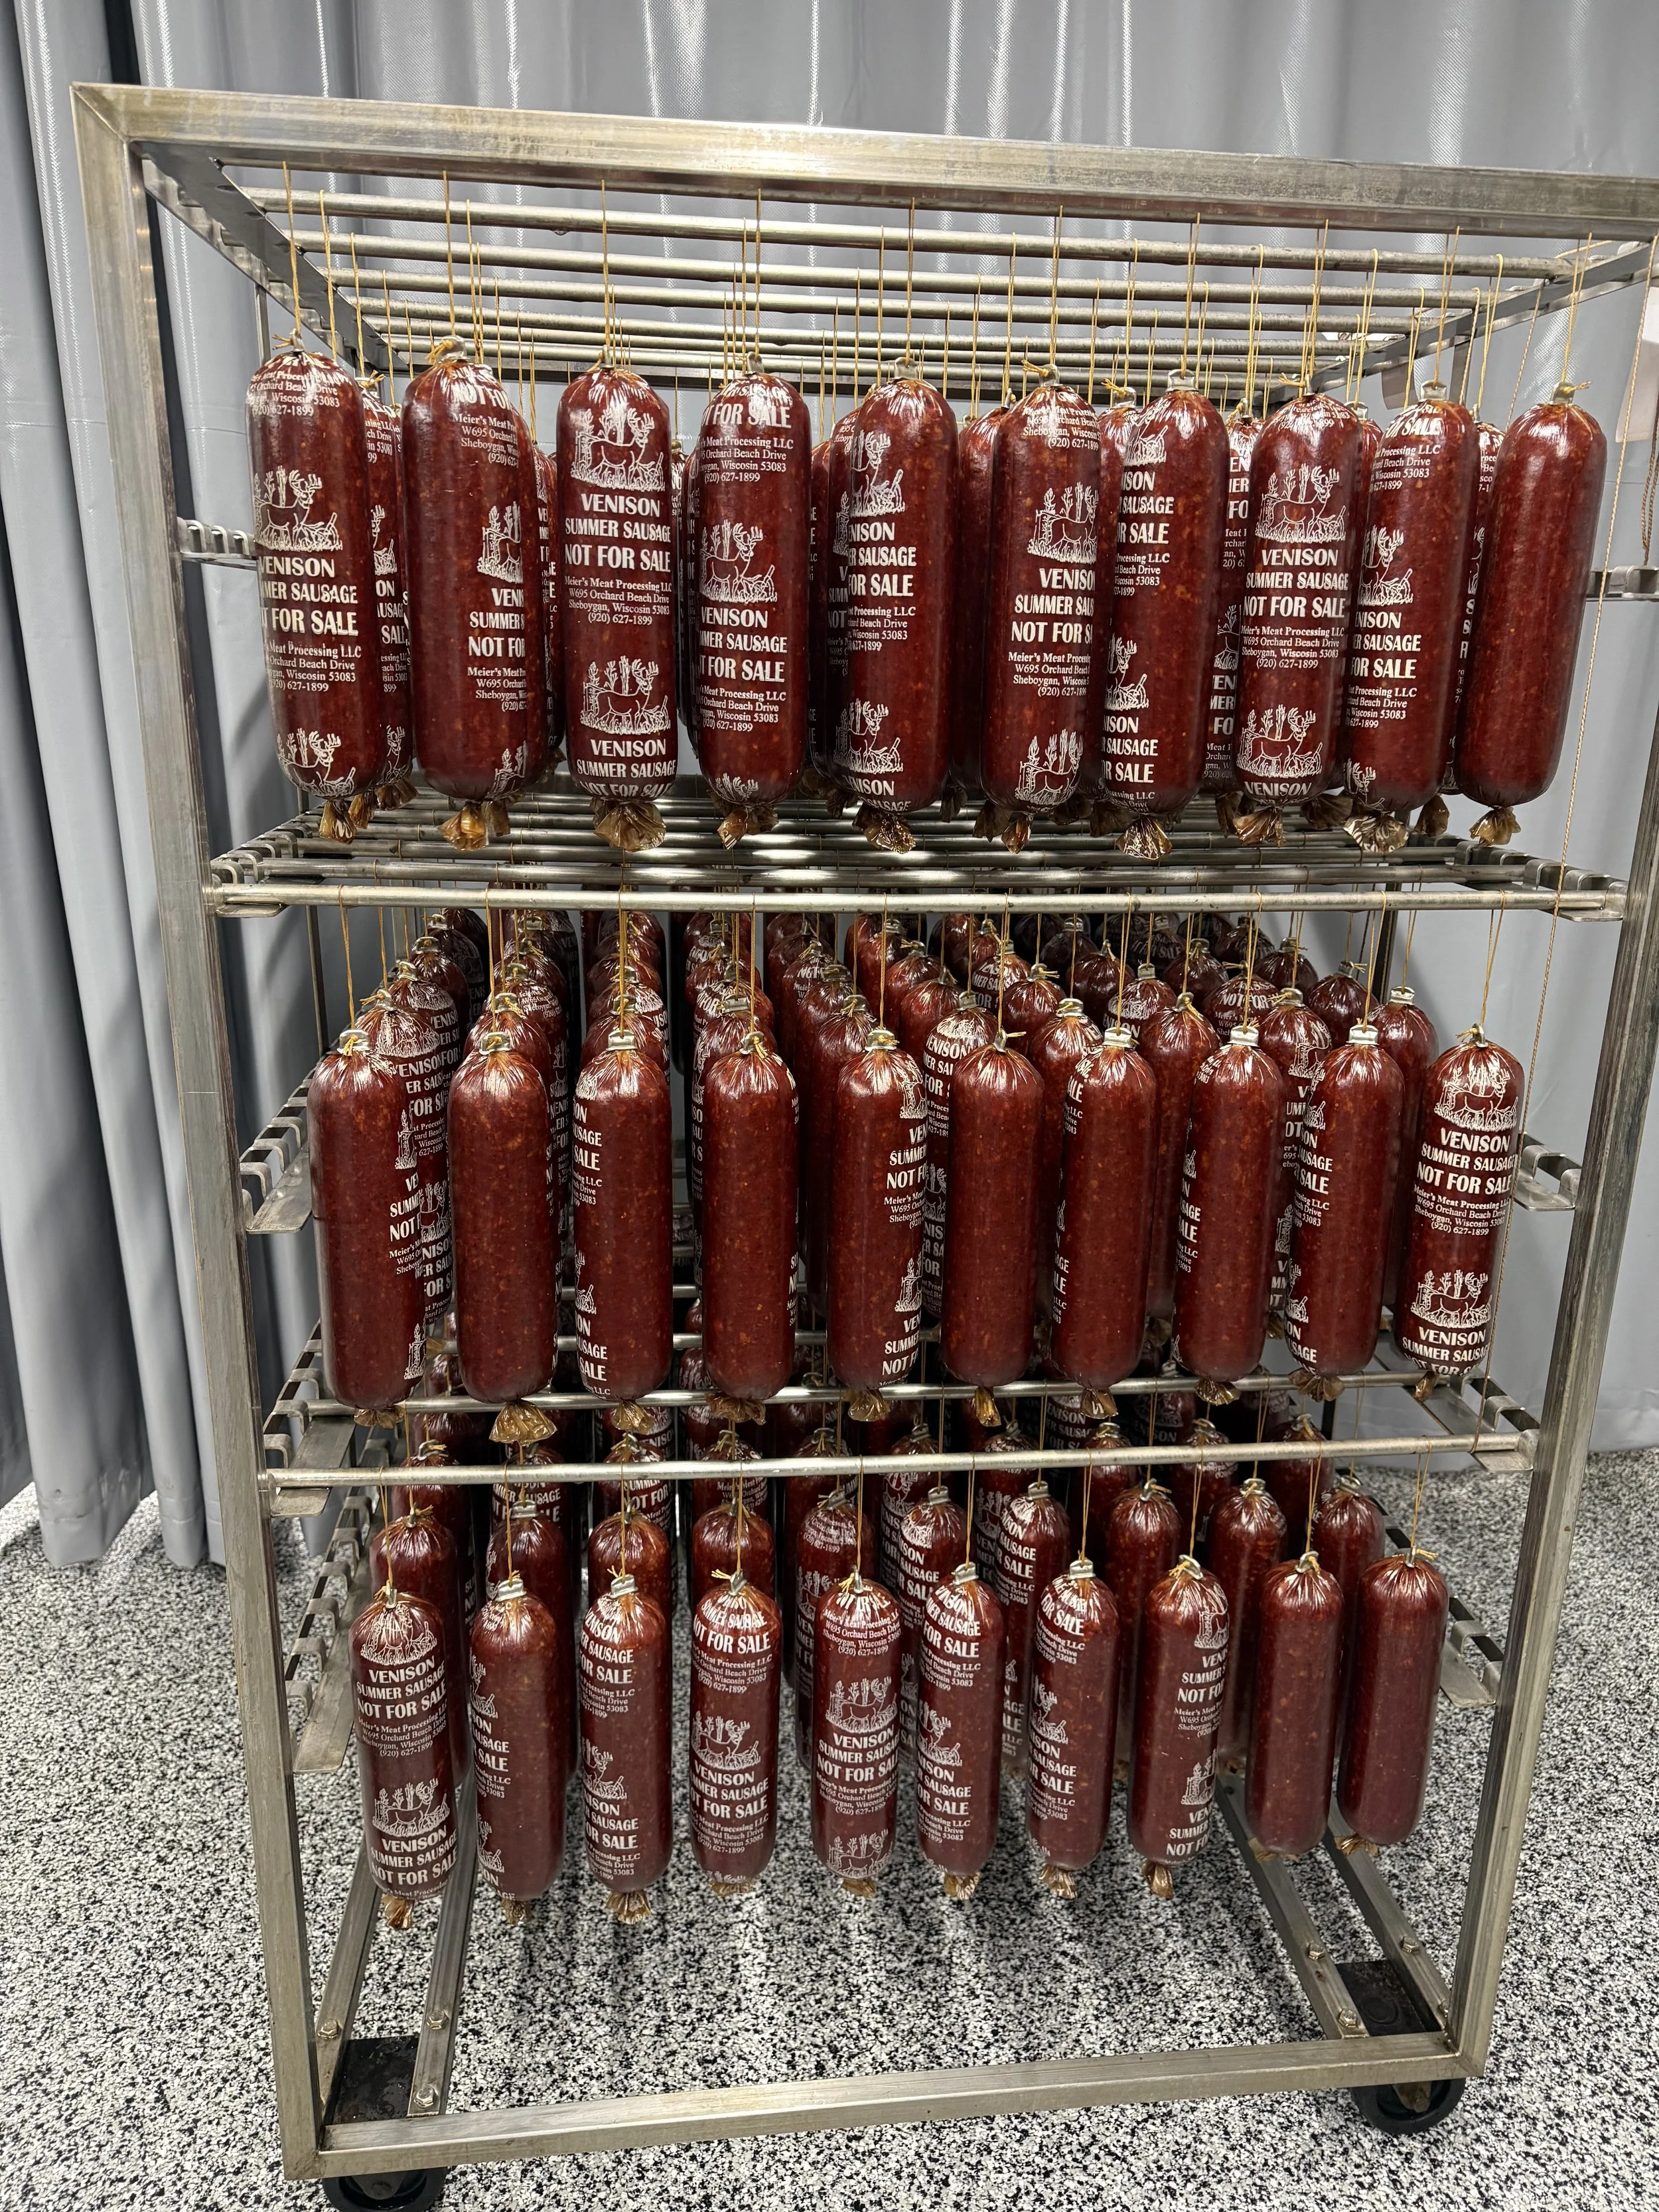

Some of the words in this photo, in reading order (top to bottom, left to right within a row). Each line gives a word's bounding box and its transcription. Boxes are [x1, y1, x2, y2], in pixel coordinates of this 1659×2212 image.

[314, 396, 340, 407] 53083
[462, 426, 487, 437] W695
[773, 437, 794, 449] LLC
[1048, 437, 1070, 449] (920)
[1071, 438, 1099, 451] 627-1899
[1418, 445, 1441, 455] LLC
[734, 448, 760, 459] Beach
[762, 449, 787, 460] Drive
[1406, 457, 1431, 466] Drive
[760, 461, 786, 472] 53083
[1403, 468, 1429, 478] 53083
[721, 472, 760, 482] 627-1899
[581, 493, 660, 518] VENISON
[1122, 496, 1175, 514] SAUSAGE
[565, 518, 618, 538] SUMMER
[623, 521, 671, 543] SAUSAGE
[1129, 522, 1170, 544] SALE
[565, 544, 593, 565] NOT
[597, 545, 635, 570] FOR
[640, 549, 671, 573] SALE
[859, 546, 916, 567] SAUSAGE
[1148, 553, 1170, 563] LLC
[1262, 548, 1338, 566] VENISON
[1138, 565, 1161, 575] Drive
[589, 577, 614, 588] Meat
[615, 579, 660, 593] Processing
[870, 573, 914, 597] SALE
[1135, 576, 1160, 585] 53083
[1246, 571, 1293, 589] SUMMER
[1297, 571, 1349, 591] SAUSAGE
[291, 582, 358, 604] SAUSAGE
[590, 589, 624, 601] Orchard
[626, 592, 652, 603] Beach
[653, 595, 670, 603] Drive
[854, 605, 892, 619] Processing
[894, 607, 916, 616] LLC
[1015, 594, 1073, 615] SUMMER
[1270, 596, 1307, 617] FOR
[1311, 597, 1346, 618] SALE
[272, 608, 305, 633] FOR
[311, 609, 359, 636] SALE
[588, 611, 611, 625] (920)
[613, 614, 653, 625] 627-1899
[701, 607, 768, 628] VENISON
[860, 618, 881, 628] Beach
[884, 619, 908, 628] Drive
[881, 630, 908, 640] 53083
[1011, 621, 1048, 642] NOT
[1052, 622, 1082, 643] FOR
[341, 644, 362, 658] LLC
[468, 636, 504, 656] NOT
[727, 633, 788, 654] SAUSAGE
[1260, 637, 1293, 647] Orchard
[1295, 638, 1320, 647] Beach
[1363, 634, 1422, 652] SAUSAGE
[299, 658, 328, 670] Beach
[330, 660, 356, 670] Drive
[1008, 652, 1041, 662] Meier's
[1256, 658, 1276, 669] (920)
[1279, 659, 1319, 668] 627-1899
[328, 672, 356, 682] 53083
[467, 667, 502, 676] Meier's
[708, 655, 736, 680] FOR
[741, 659, 785, 683] SALE
[1015, 664, 1039, 673] W695
[1041, 664, 1073, 674] Orchard
[1373, 658, 1417, 679] SALE
[287, 681, 329, 692] 627-1899
[476, 679, 501, 688] W695
[1037, 687, 1060, 698] (920)
[1394, 687, 1417, 698] LLC
[719, 688, 764, 701] Processing
[766, 691, 786, 701] LLC
[1383, 698, 1407, 708] Drive
[728, 700, 753, 711] Beach
[755, 701, 779, 712] Drive
[1380, 709, 1406, 719] 53083
[753, 713, 778, 723] 53083
[590, 739, 666, 757] VENISON
[1106, 737, 1159, 756] SAUSAGE
[577, 759, 626, 778] SUMMER
[630, 759, 676, 778] SAUSAGE
[1115, 762, 1155, 783] SALE
[1223, 993, 1244, 1007] NOT
[924, 1073, 943, 1096] FOR
[1441, 1127, 1510, 1153] VENISON
[574, 1144, 601, 1171] SALE
[1421, 1142, 1471, 1169] SUMMER
[585, 1175, 603, 1187] LLC
[887, 1168, 916, 1189] NOT
[1299, 1168, 1329, 1195] SALE
[1417, 1161, 1445, 1187] NOT
[1446, 1172, 1481, 1194] FOR
[580, 1184, 596, 1195] Drive
[579, 1193, 597, 1205] 53083
[884, 1195, 911, 1205] Meier's
[891, 1203, 910, 1213] W695
[1311, 1198, 1329, 1210] LLC
[1417, 1195, 1435, 1209] W695
[1435, 1204, 1467, 1217] Orchard
[1469, 1211, 1490, 1219] Beach
[1437, 1195, 1459, 1207] Meat
[1461, 1200, 1499, 1211] Processing
[1302, 1213, 1321, 1226] 53083
[1304, 1205, 1321, 1217] Drive
[390, 1217, 415, 1242] NOT
[1431, 1221, 1452, 1233] (920)
[1453, 1227, 1489, 1236] 627-1899
[1455, 1217, 1488, 1228] Wiscosin
[389, 1244, 415, 1258] Meier's
[1419, 1326, 1486, 1346] VENISON
[1402, 1337, 1449, 1361] SUMMER
[1018, 1582, 1035, 1591] LLC
[938, 1611, 981, 1637] SAUSAGE
[1053, 1609, 1084, 1637] SALE
[706, 1629, 734, 1653] FOR
[737, 1631, 771, 1655] SALE
[841, 1629, 867, 1639] Orchard
[869, 1627, 887, 1639] Beach
[923, 1619, 942, 1649] FOR
[944, 1637, 979, 1658] SALE
[588, 1640, 634, 1664] SAUSAGE
[837, 1645, 856, 1657] (920)
[857, 1645, 889, 1656] 627-1899
[1066, 1639, 1086, 1651] LLC
[368, 1655, 435, 1683] VENISON
[597, 1665, 632, 1684] SALE
[356, 1681, 402, 1700] SUMMER
[405, 1660, 445, 1696] SAUSAGE
[1178, 1688, 1206, 1703] NOT
[357, 1698, 382, 1718] NOT
[386, 1701, 417, 1720] FOR
[833, 1724, 894, 1749] VENISON
[478, 1747, 508, 1772] SALE
[819, 1739, 863, 1763] SUMMER
[694, 1759, 755, 1786] VENISON
[818, 1753, 842, 1779] NOT
[845, 1767, 875, 1782] FOR
[721, 1777, 768, 1801] SAUSAGE
[924, 1775, 972, 1798] SAUSAGE
[1041, 1771, 1074, 1795] SALE
[703, 1798, 731, 1819] FOR
[735, 1795, 767, 1818] SALE
[934, 1797, 969, 1815] SALE
[1057, 1797, 1076, 1806] LLC
[591, 1811, 638, 1831] SAUSAGE
[382, 1824, 447, 1852] VENISON
[602, 1833, 638, 1850] SALE
[372, 1862, 394, 1883] NOT
[397, 1869, 428, 1885] FOR
